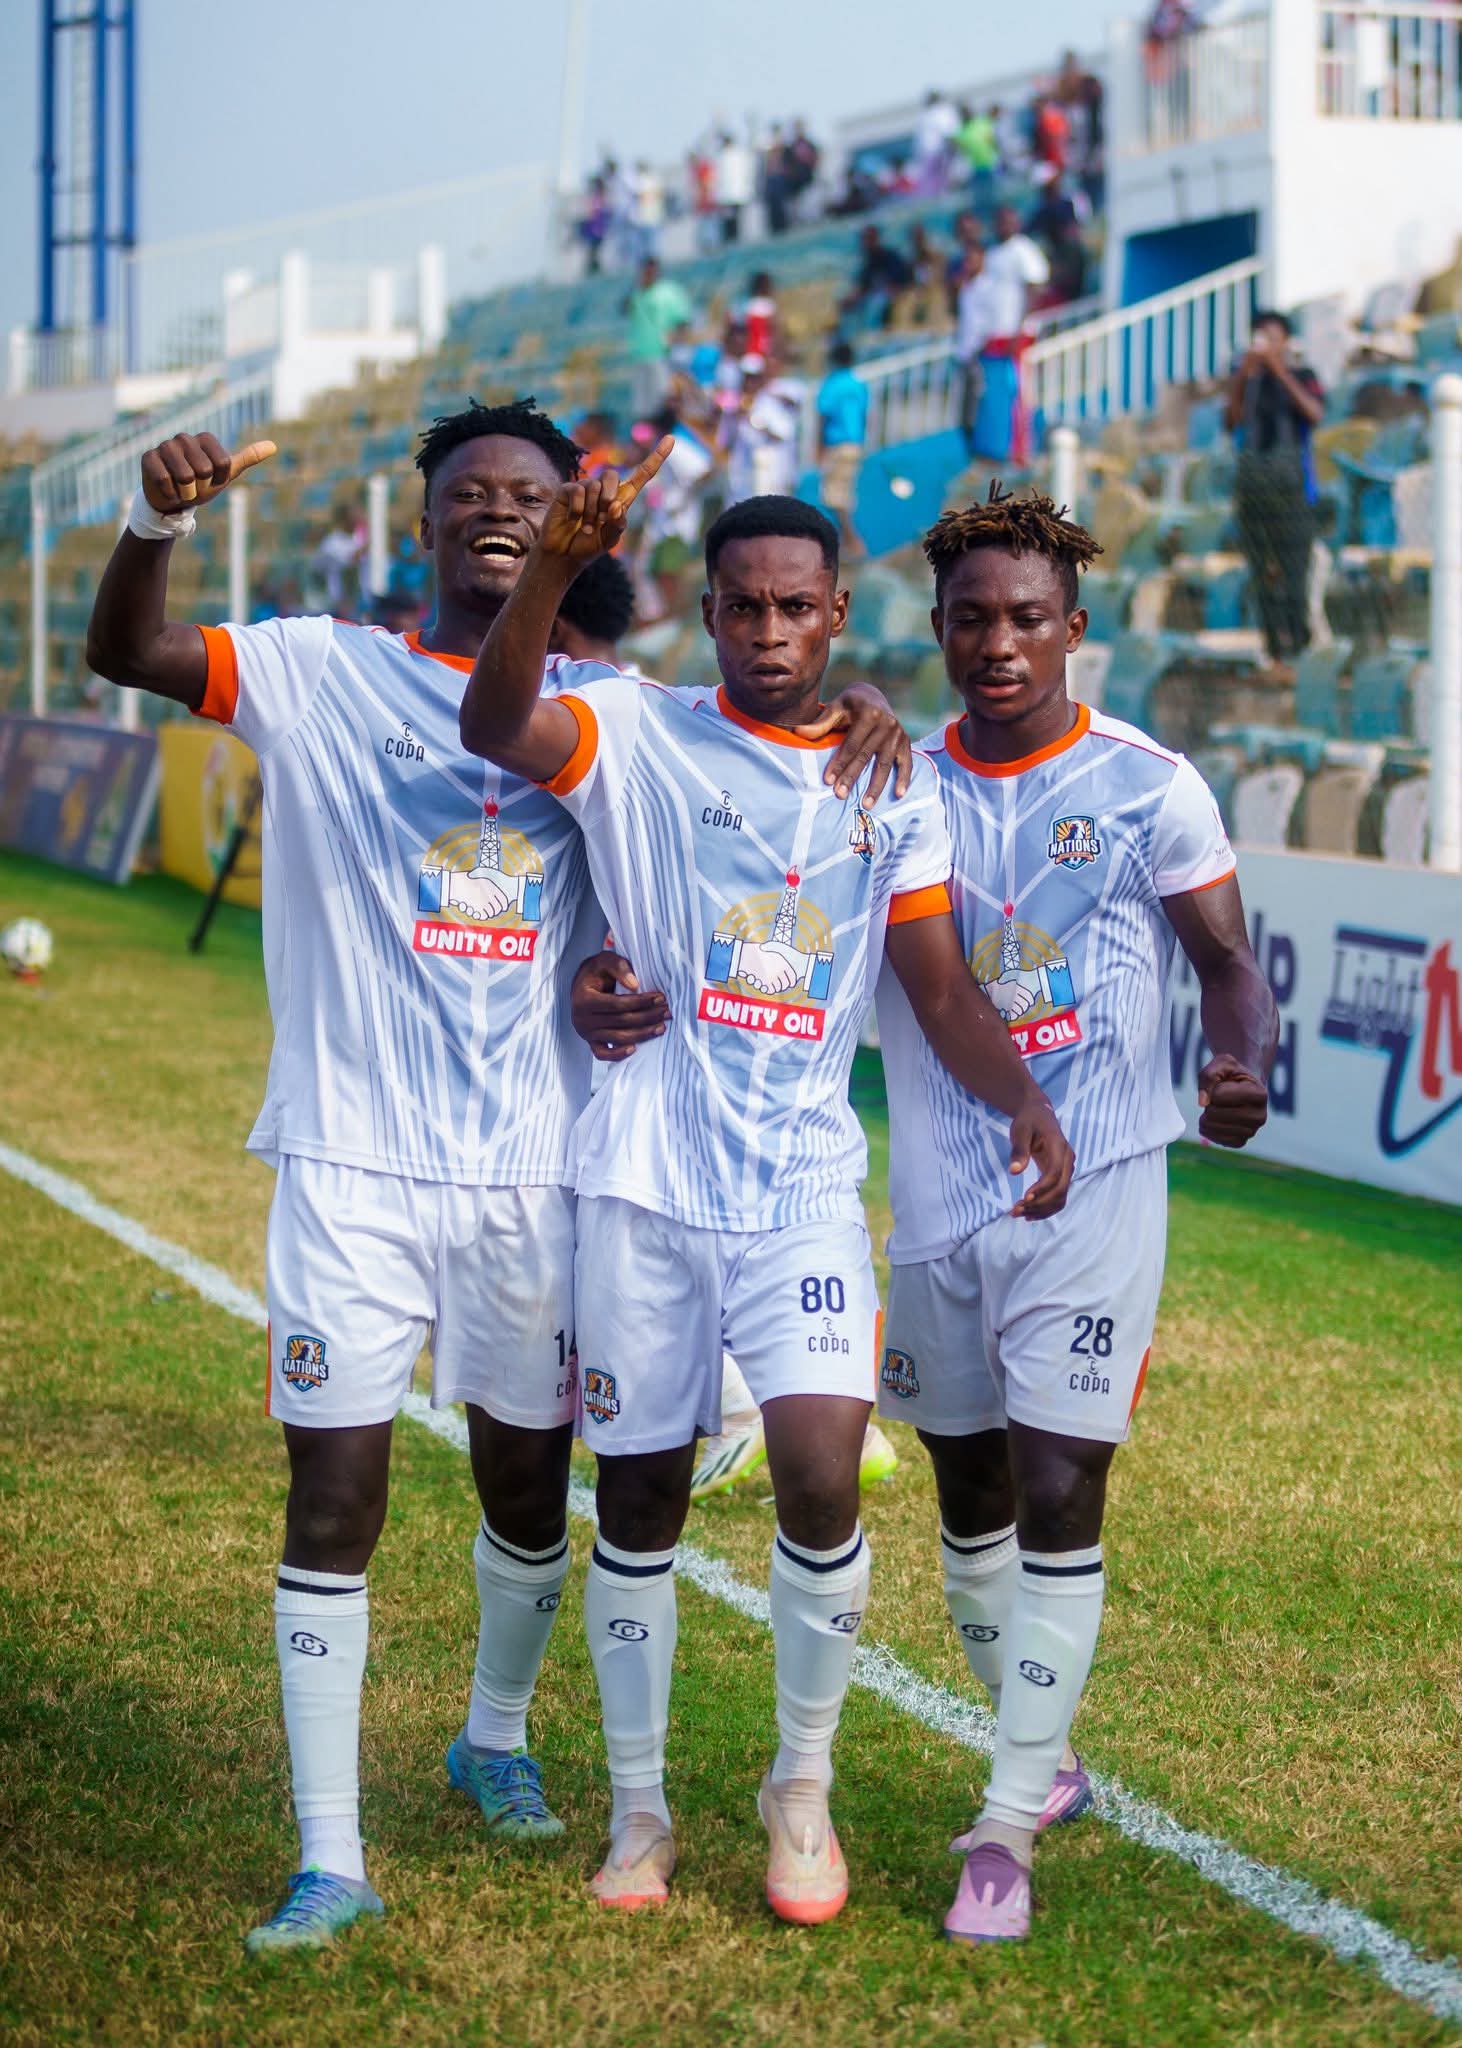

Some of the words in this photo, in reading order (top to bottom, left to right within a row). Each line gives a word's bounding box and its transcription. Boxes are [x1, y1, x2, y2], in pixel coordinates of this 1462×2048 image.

[385, 737, 425, 762] COPA
[702, 807, 743, 832] COPA
[1050, 839, 1099, 857] NATIONS
[420, 927, 493, 954] UNITY
[499, 935, 532, 957] OIL
[706, 996, 778, 1029] UNITY
[784, 1012, 818, 1036] OIL
[1035, 1018, 1077, 1047] OIL
[801, 1276, 845, 1313] 80
[808, 1336, 849, 1355] COPA
[1070, 1315, 1114, 1357] 28
[283, 1358, 328, 1379] NATIONS
[556, 1376, 577, 1398] COP
[1069, 1373, 1110, 1395] COPA
[584, 1390, 619, 1413] NATIONS
